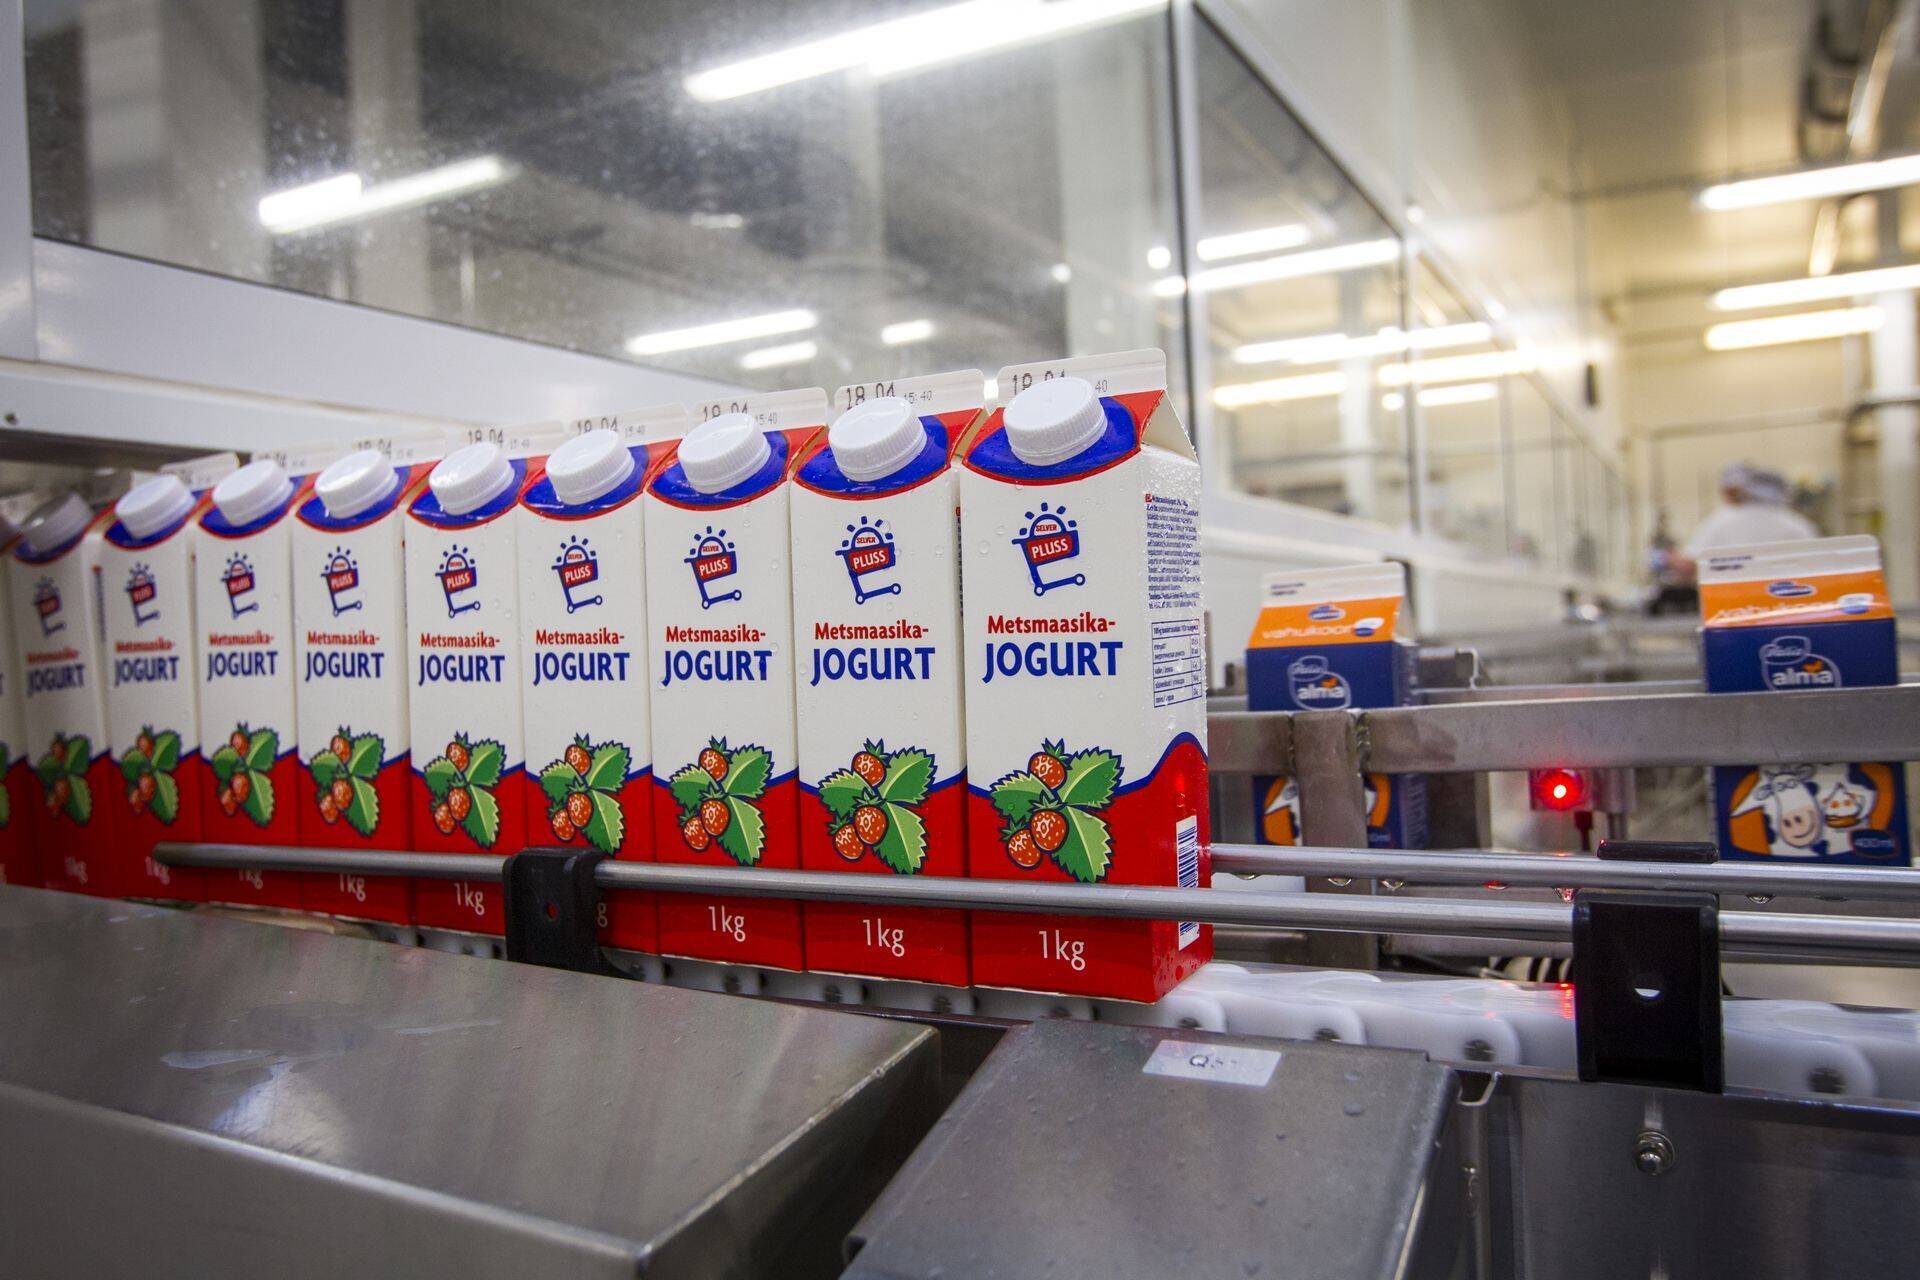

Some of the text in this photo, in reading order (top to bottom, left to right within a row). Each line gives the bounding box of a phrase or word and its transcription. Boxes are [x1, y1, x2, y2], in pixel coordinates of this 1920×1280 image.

[1035, 523, 1057, 533] SELVER
[853, 550, 886, 569] PLUSS
[1032, 538, 1070, 559] PLUSS
[565, 565, 591, 583] PLUSS
[700, 558, 728, 576] PLUSS
[446, 572, 471, 589] PLUSS
[666, 624, 766, 643] Metsmaasika-
[815, 619, 929, 640] Metsmaasika-
[987, 612, 1116, 634] Metsmaasika-
[307, 629, 380, 646] Metsmaasika-
[420, 631, 500, 648] Metsmaasika-
[536, 627, 625, 645] Metsmaasika-
[114, 656, 179, 689] JOGURT
[207, 651, 278, 682] JOGURT
[305, 651, 384, 682] JOGURT
[418, 654, 505, 687] JOGURT
[533, 652, 630, 687] JOGURT
[661, 650, 772, 687] JOGURT
[810, 647, 935, 687] JOGURT
[982, 641, 1123, 684] JOGURT
[1771, 668, 1834, 686] alma
[454, 881, 485, 916] 1kg
[708, 905, 746, 942] 1kg
[862, 918, 905, 958] 1kg
[1038, 930, 1086, 971] 1kg
